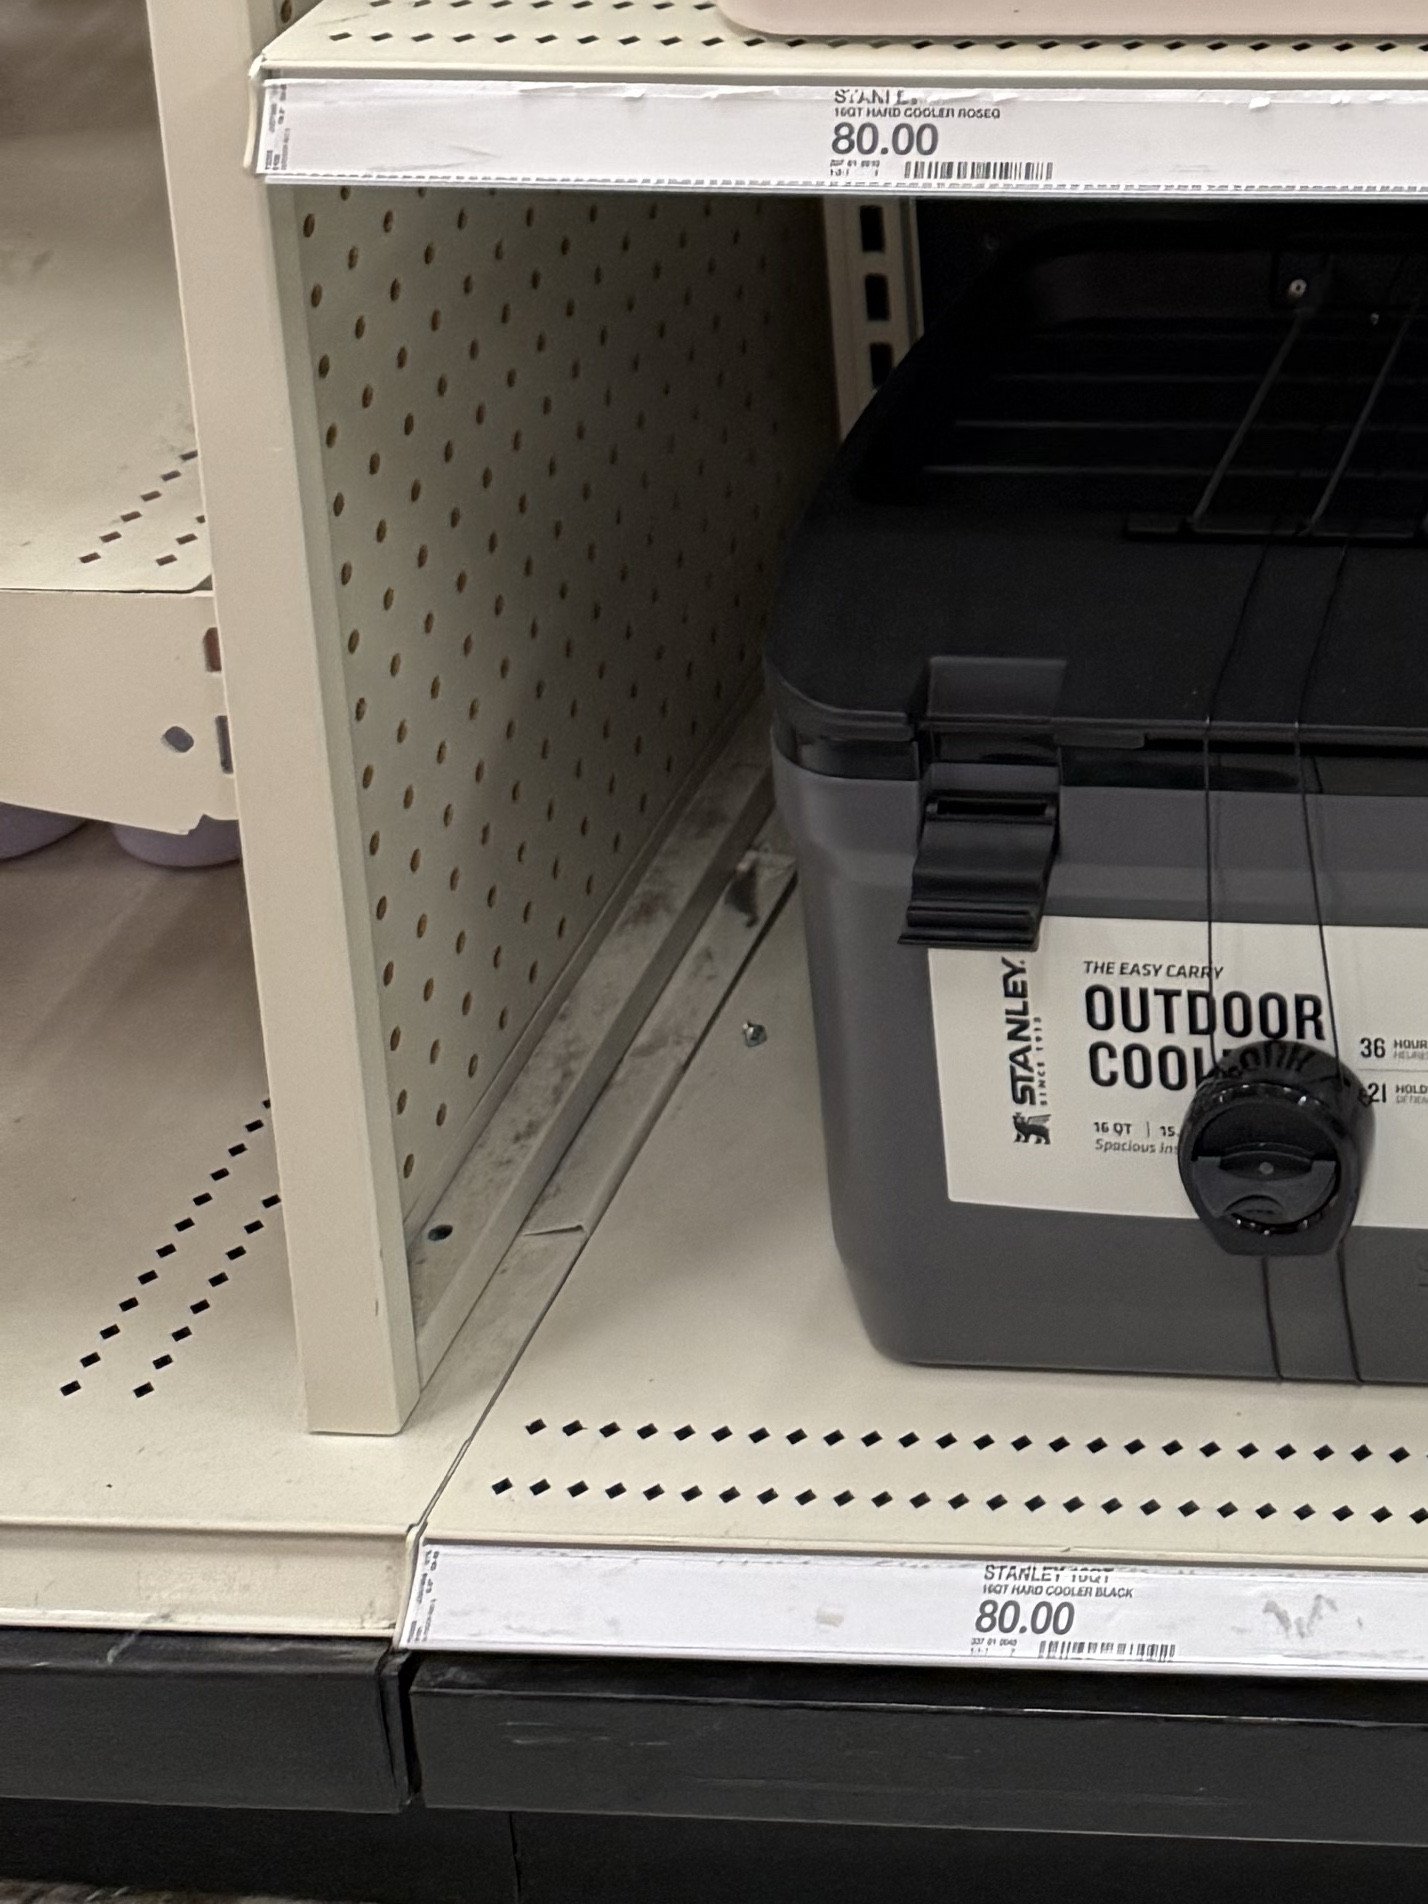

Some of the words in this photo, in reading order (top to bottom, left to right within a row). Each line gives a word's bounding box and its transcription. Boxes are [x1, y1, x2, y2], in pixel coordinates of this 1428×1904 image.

[866, 107, 900, 118] HARD
[903, 107, 954, 118] COOLER
[832, 122, 939, 155] 80.00
[1084, 960, 1116, 975] THE
[1119, 961, 1163, 977] EASY
[1166, 963, 1224, 980] CARRY
[1085, 983, 1327, 1041] OUTDOOR
[1001, 955, 1037, 1107] STANLEY
[1360, 1037, 1386, 1058] 36
[1367, 1082, 1387, 1103] 21
[1093, 1121, 1111, 1134] 16
[1113, 1122, 1132, 1136] QT
[1095, 1138, 1156, 1155] Spacious
[983, 1564, 1061, 1582] STANLEY
[1010, 1584, 1043, 1596] HARD
[1045, 1585, 1092, 1597] COOLER
[1094, 1586, 1133, 1599] BLACK
[975, 1599, 1075, 1635] 80.00
